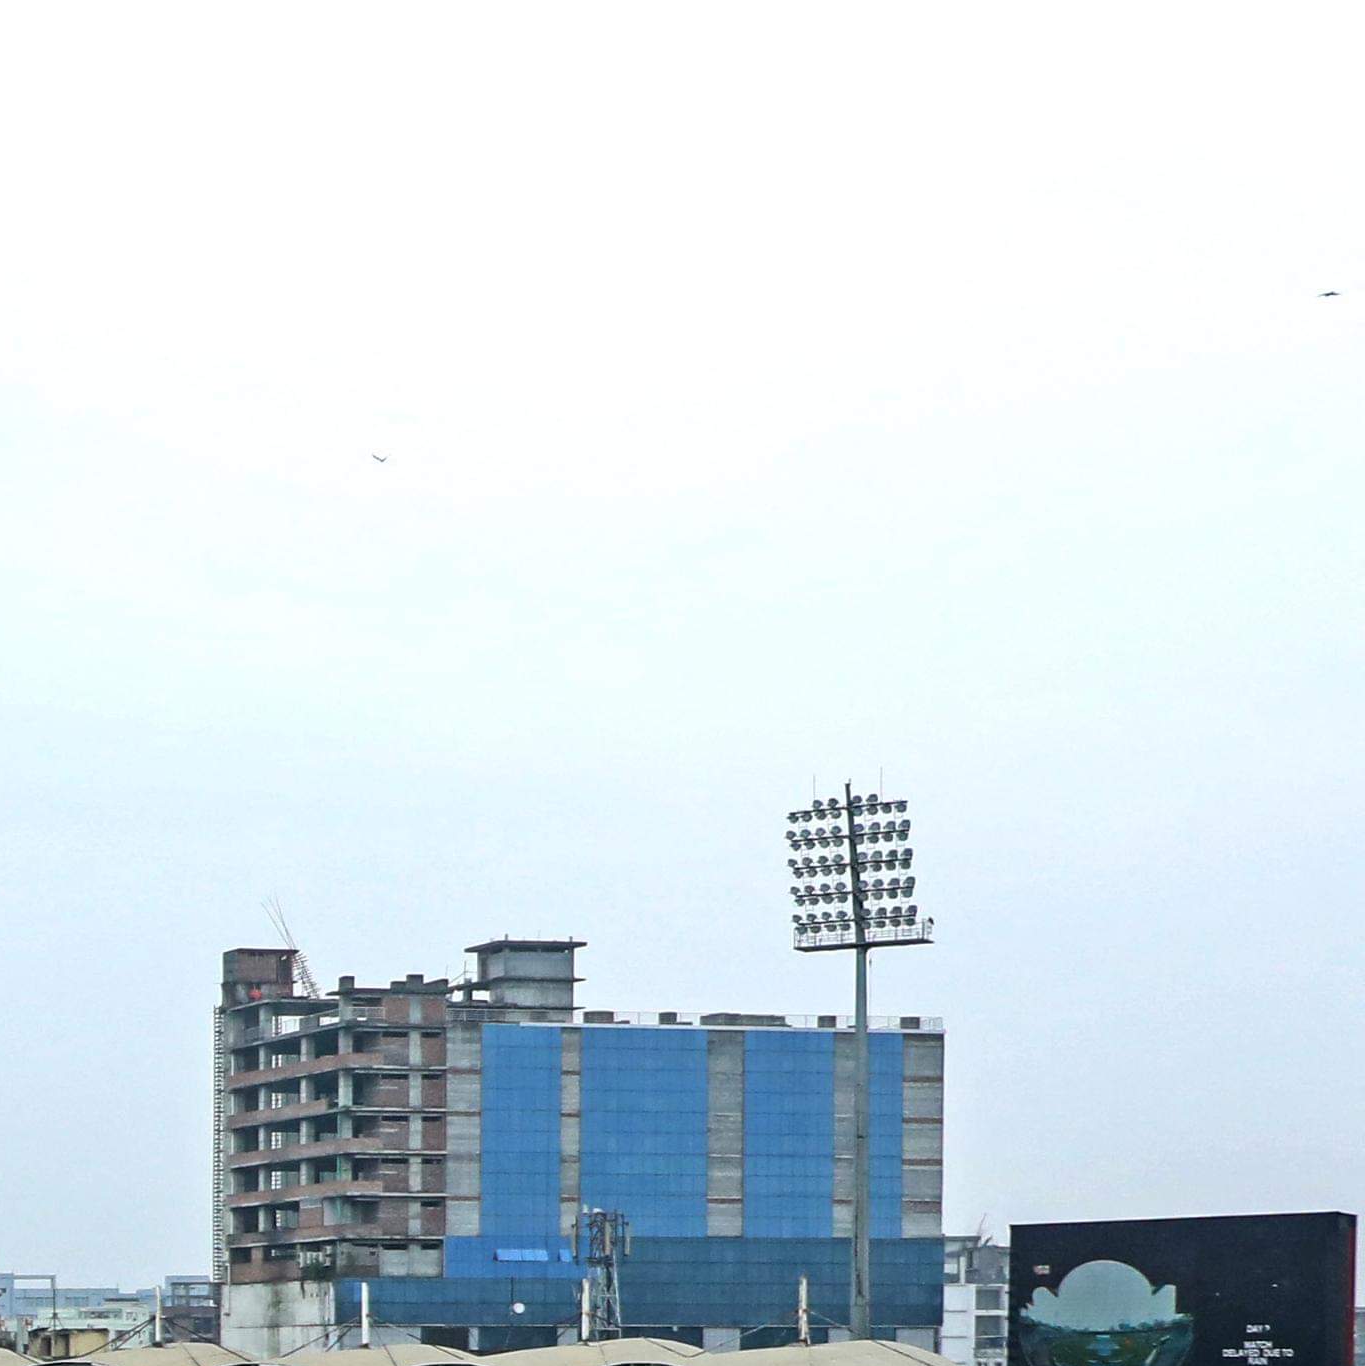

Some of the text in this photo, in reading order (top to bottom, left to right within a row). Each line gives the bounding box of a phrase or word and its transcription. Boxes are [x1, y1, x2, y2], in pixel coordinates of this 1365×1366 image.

[1222, 1349, 1294, 1357] DELAYED DUE TO
